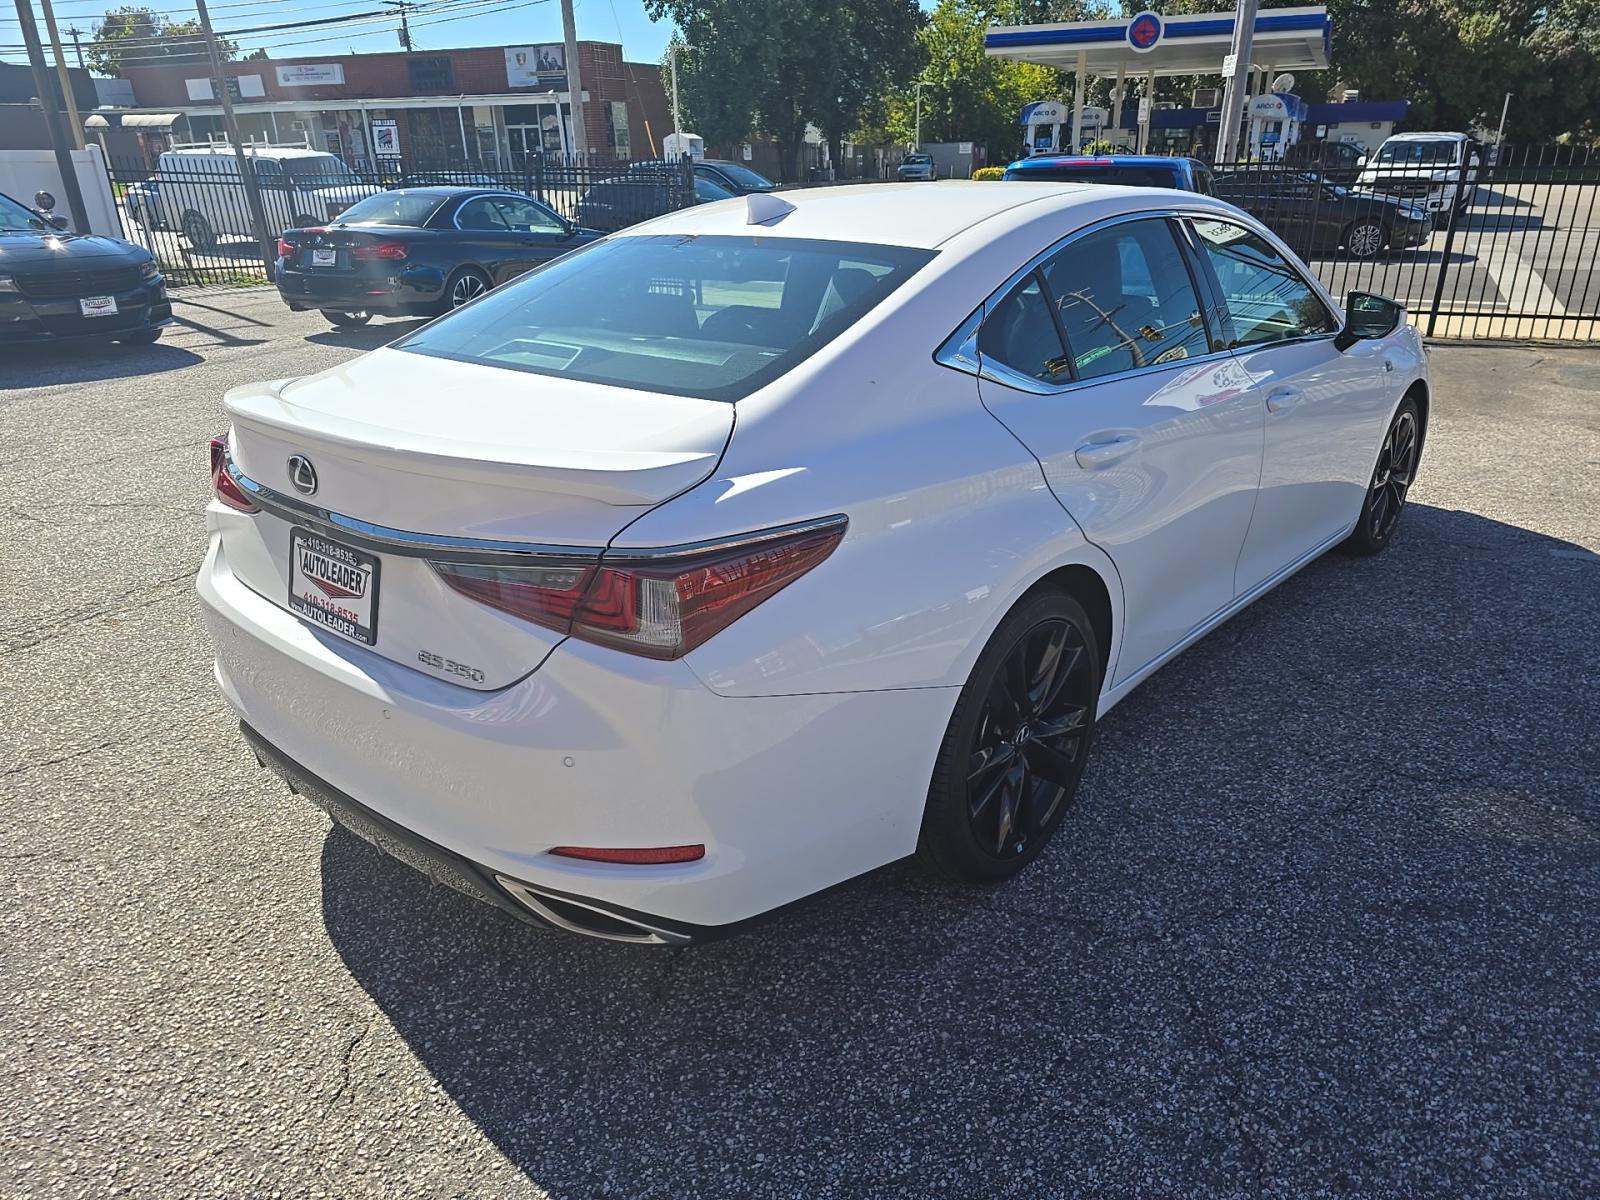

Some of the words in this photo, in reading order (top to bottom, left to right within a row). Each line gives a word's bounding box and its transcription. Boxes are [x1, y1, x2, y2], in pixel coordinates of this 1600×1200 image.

[303, 551, 362, 594] AUTOLEADER
[303, 591, 359, 624] 410-318-8535
[417, 649, 444, 669] ES
[444, 659, 485, 683] 350
